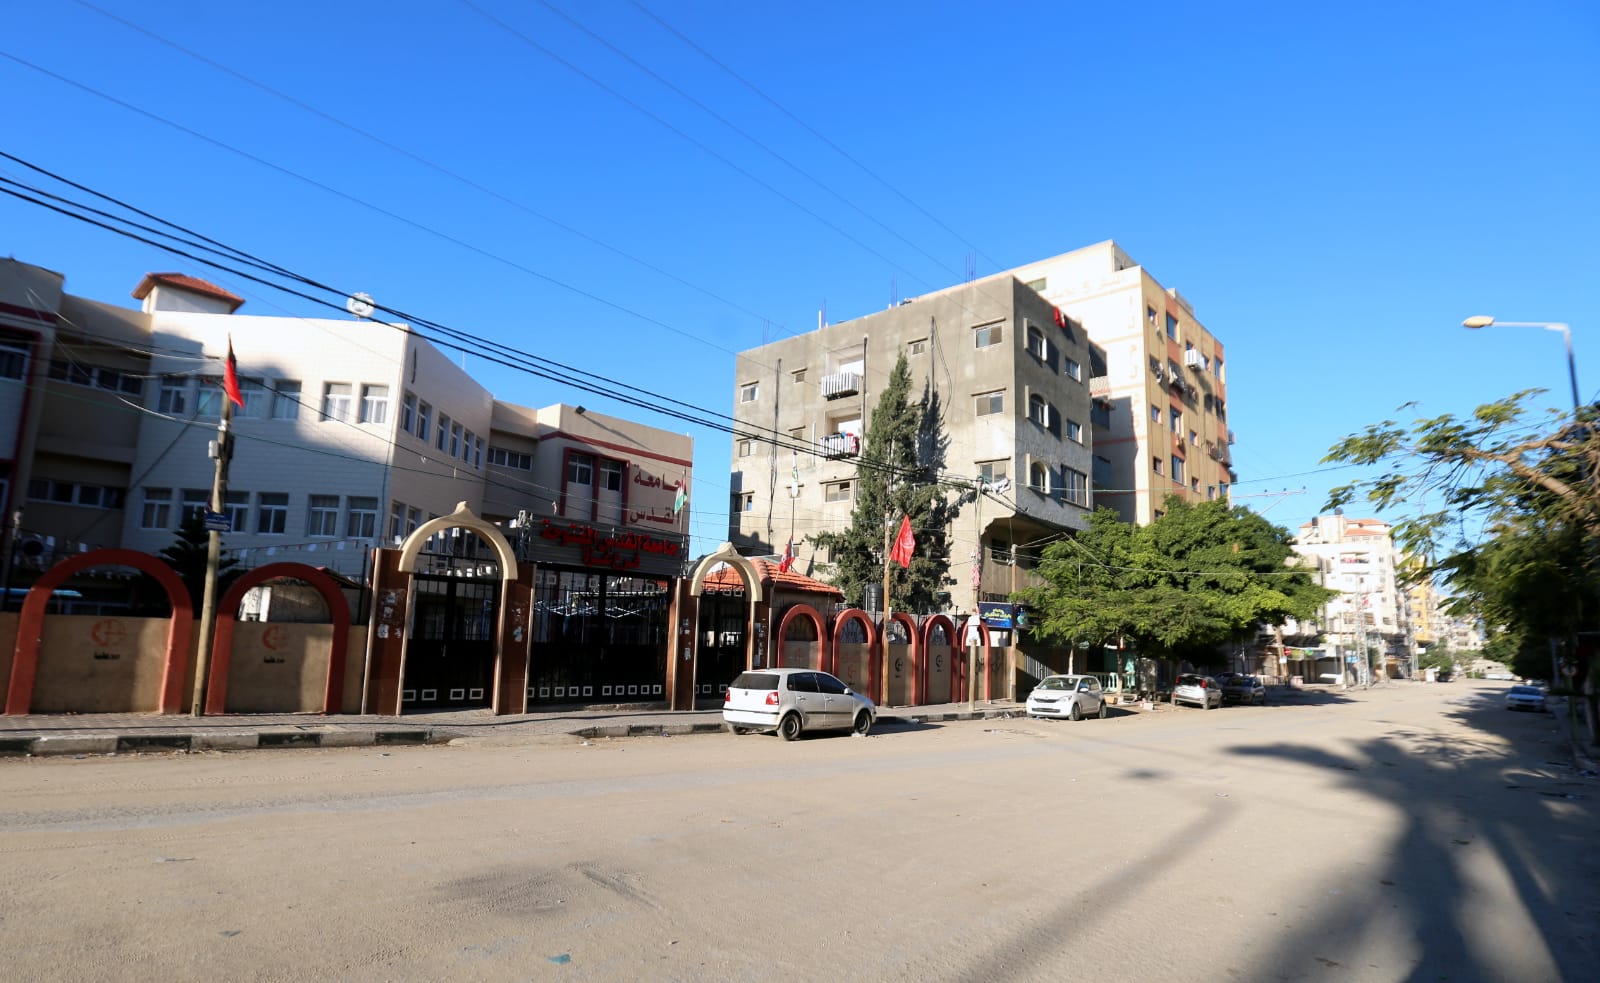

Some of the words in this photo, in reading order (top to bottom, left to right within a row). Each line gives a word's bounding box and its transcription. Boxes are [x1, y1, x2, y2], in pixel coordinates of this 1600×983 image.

[634, 464, 682, 491] جامعة
[630, 506, 679, 524] القدس
[599, 531, 642, 552] القدس
[642, 533, 679, 556] جامعة
